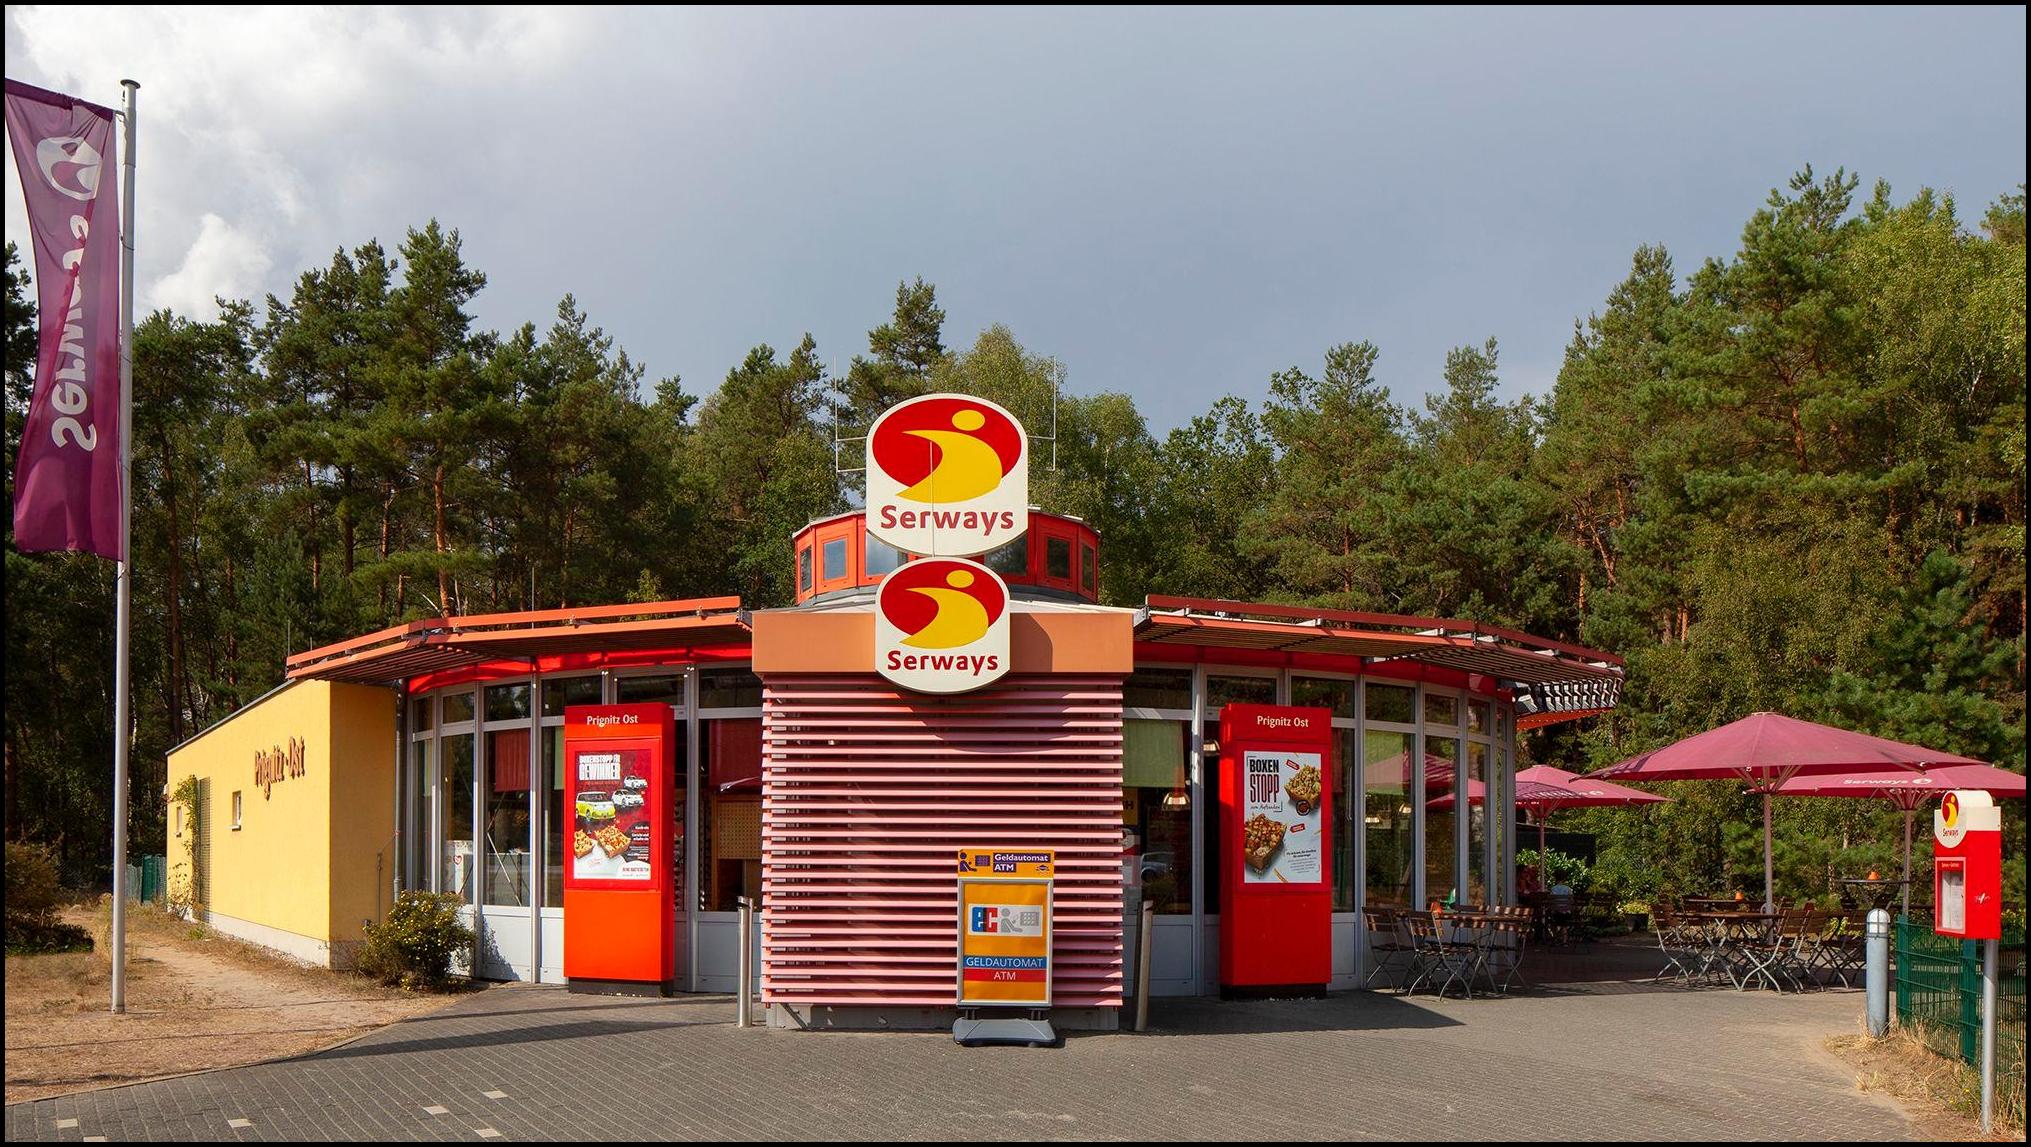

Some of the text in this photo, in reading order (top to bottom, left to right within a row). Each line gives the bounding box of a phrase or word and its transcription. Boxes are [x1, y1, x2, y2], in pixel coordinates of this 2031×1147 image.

[880, 504, 1014, 536] Serways
[887, 650, 999, 676] Serways
[586, 714, 639, 728] Prignitz Ost
[1257, 715, 1309, 729] Prignitz Ost
[1249, 759, 1280, 773] BOXEN
[1249, 773, 1280, 803] STOPP
[1842, 778, 1909, 786] Serways
[994, 853, 1049, 863] Geldautomat
[994, 863, 1015, 872] ATM
[966, 957, 1043, 968] GELDAUTOMAT
[993, 970, 1016, 981] ATM
